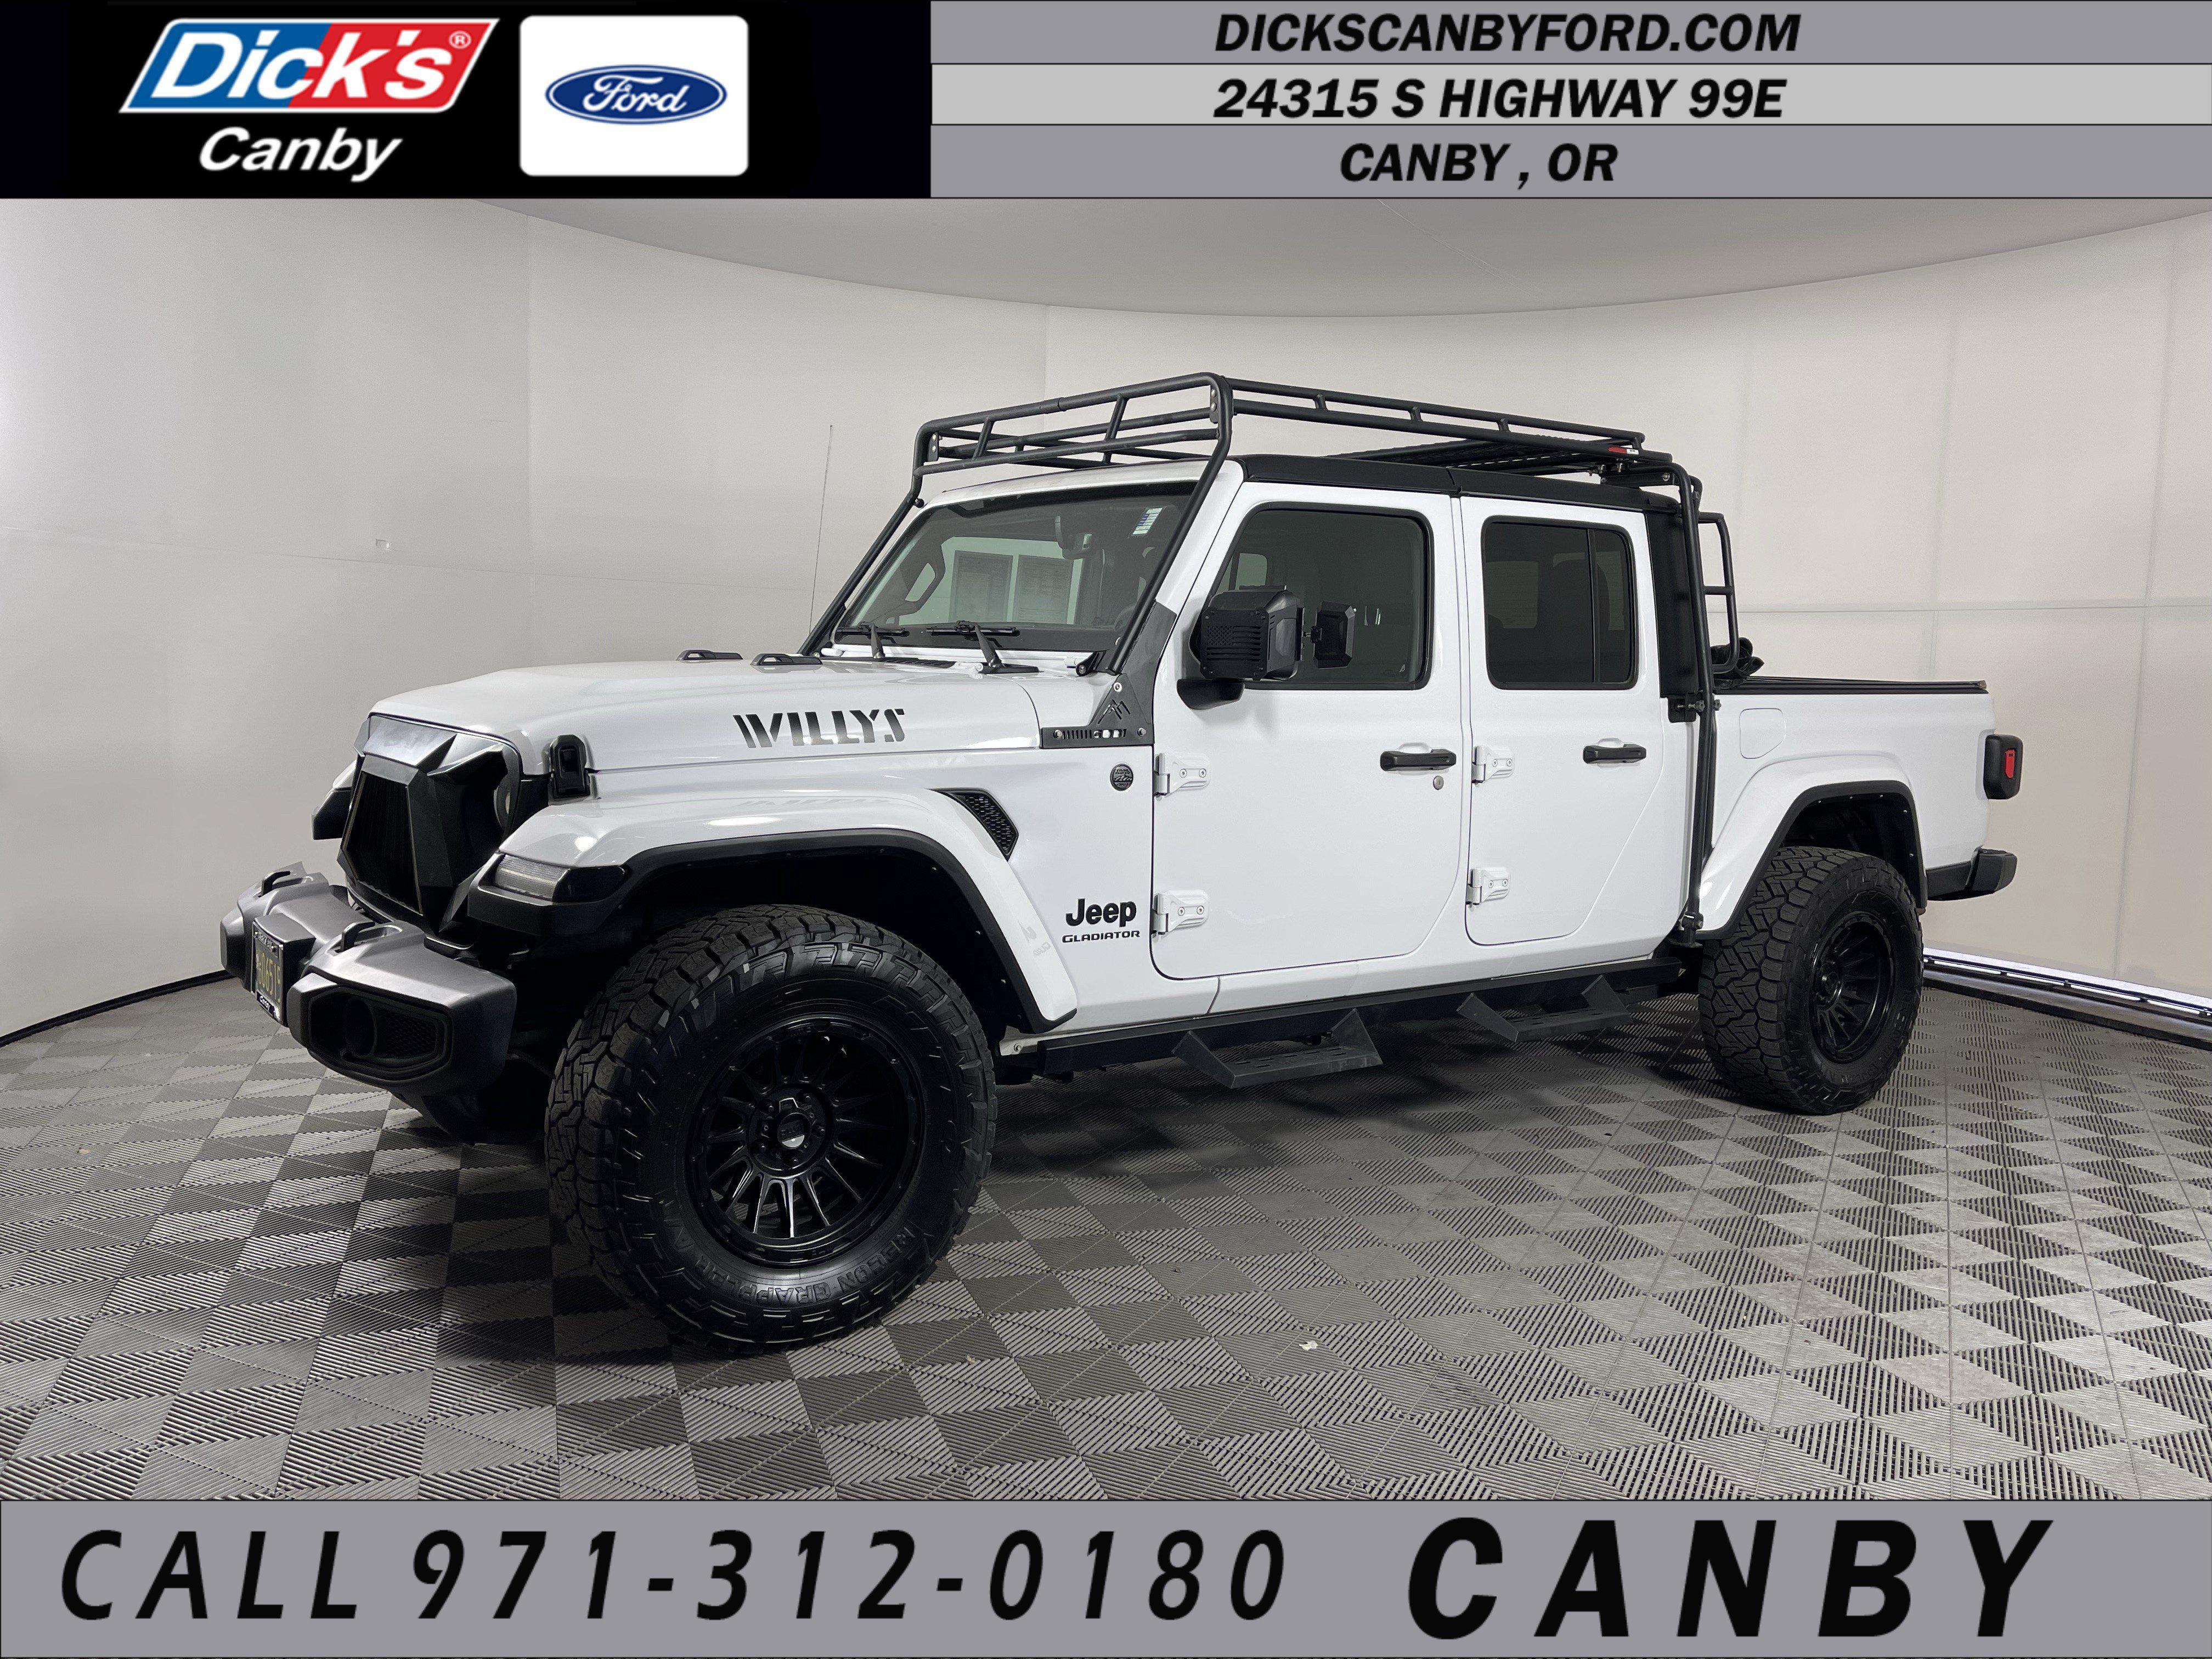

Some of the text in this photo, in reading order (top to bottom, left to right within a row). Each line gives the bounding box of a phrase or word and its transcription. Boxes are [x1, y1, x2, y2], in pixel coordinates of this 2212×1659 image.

[732, 708, 905, 748] WILLYS
[1065, 898, 1137, 928] Jeep
[1062, 930, 1141, 943] GLADIATOR
[695, 1255, 832, 1307] GRAPPLER
